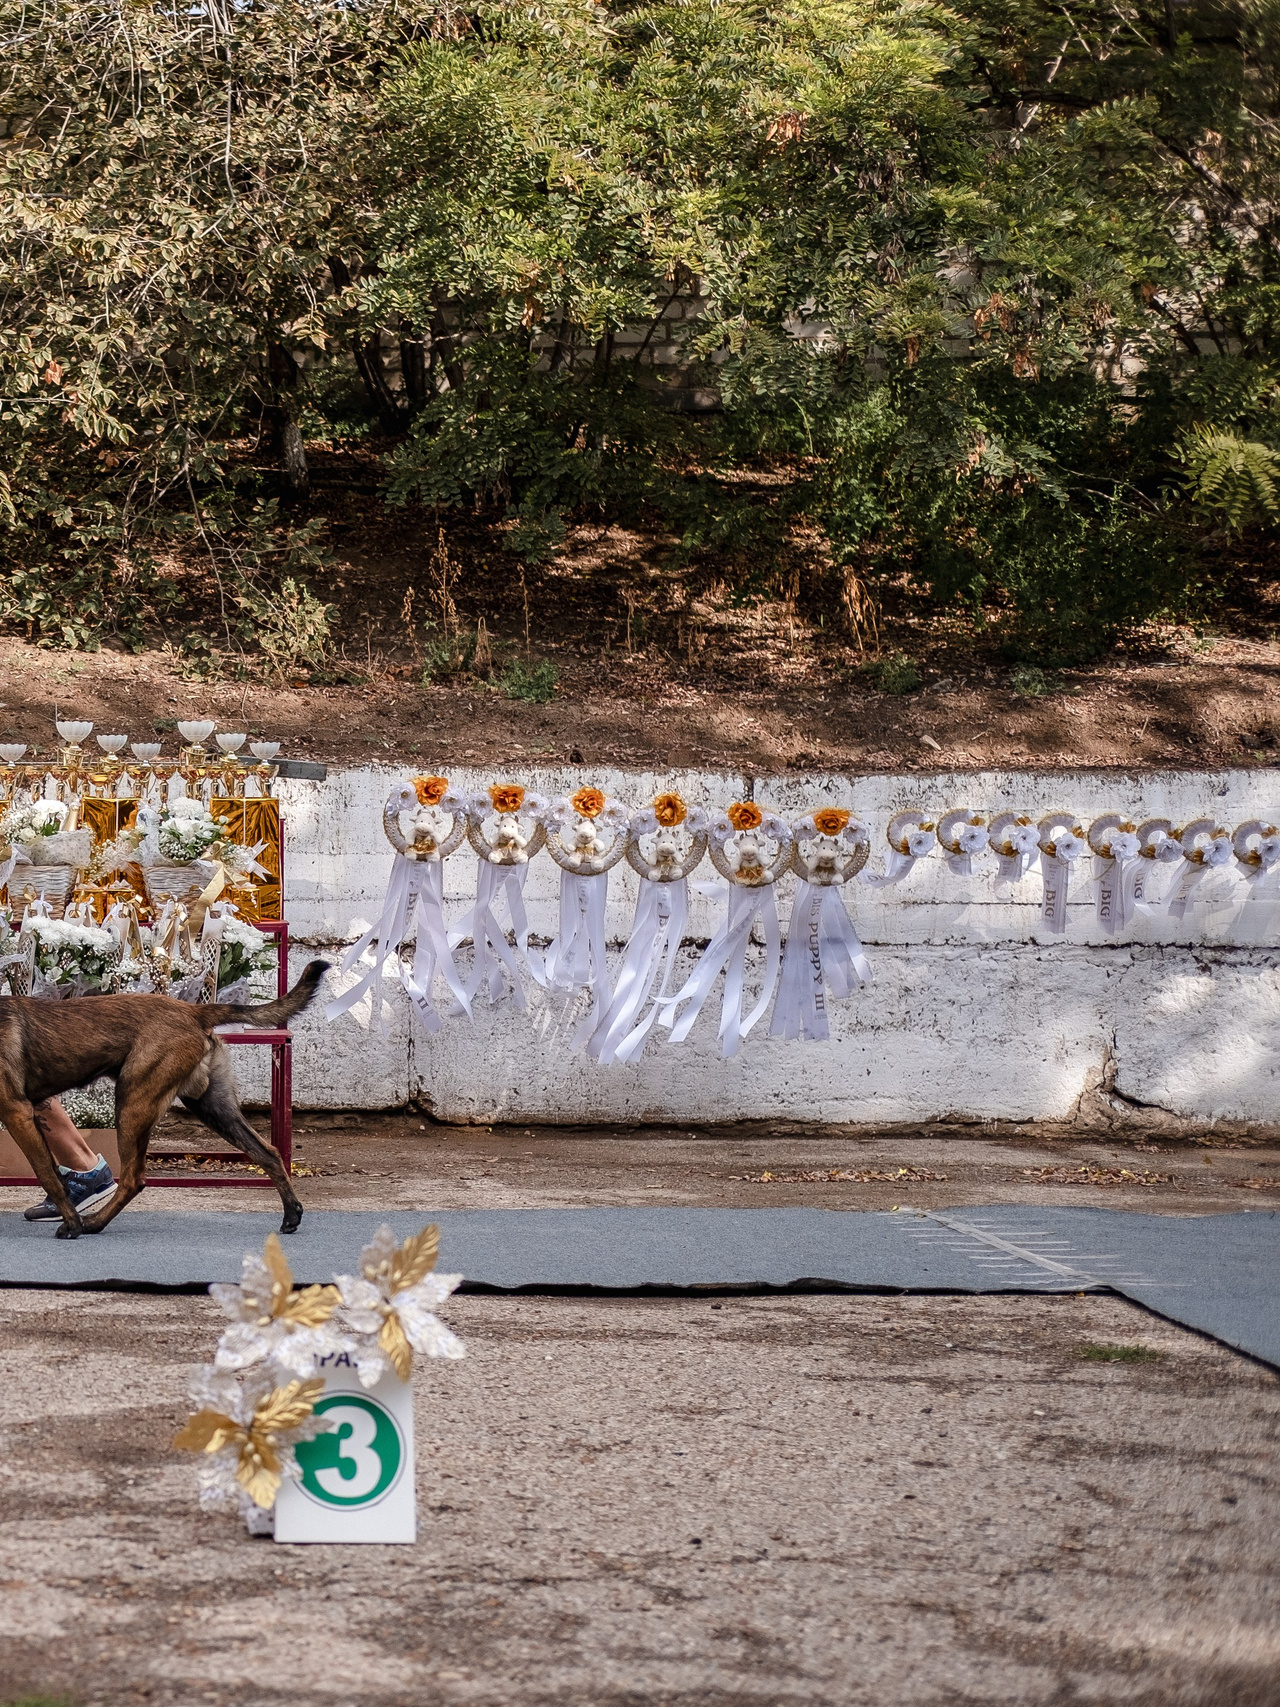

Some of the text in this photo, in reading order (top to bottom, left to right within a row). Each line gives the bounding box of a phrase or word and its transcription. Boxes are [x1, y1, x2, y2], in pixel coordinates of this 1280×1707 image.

[1044, 889, 1056, 918] BIG
[1100, 889, 1112, 918] BIG
[808, 922, 823, 986] PUPPY
[314, 1405, 382, 1498] 3
